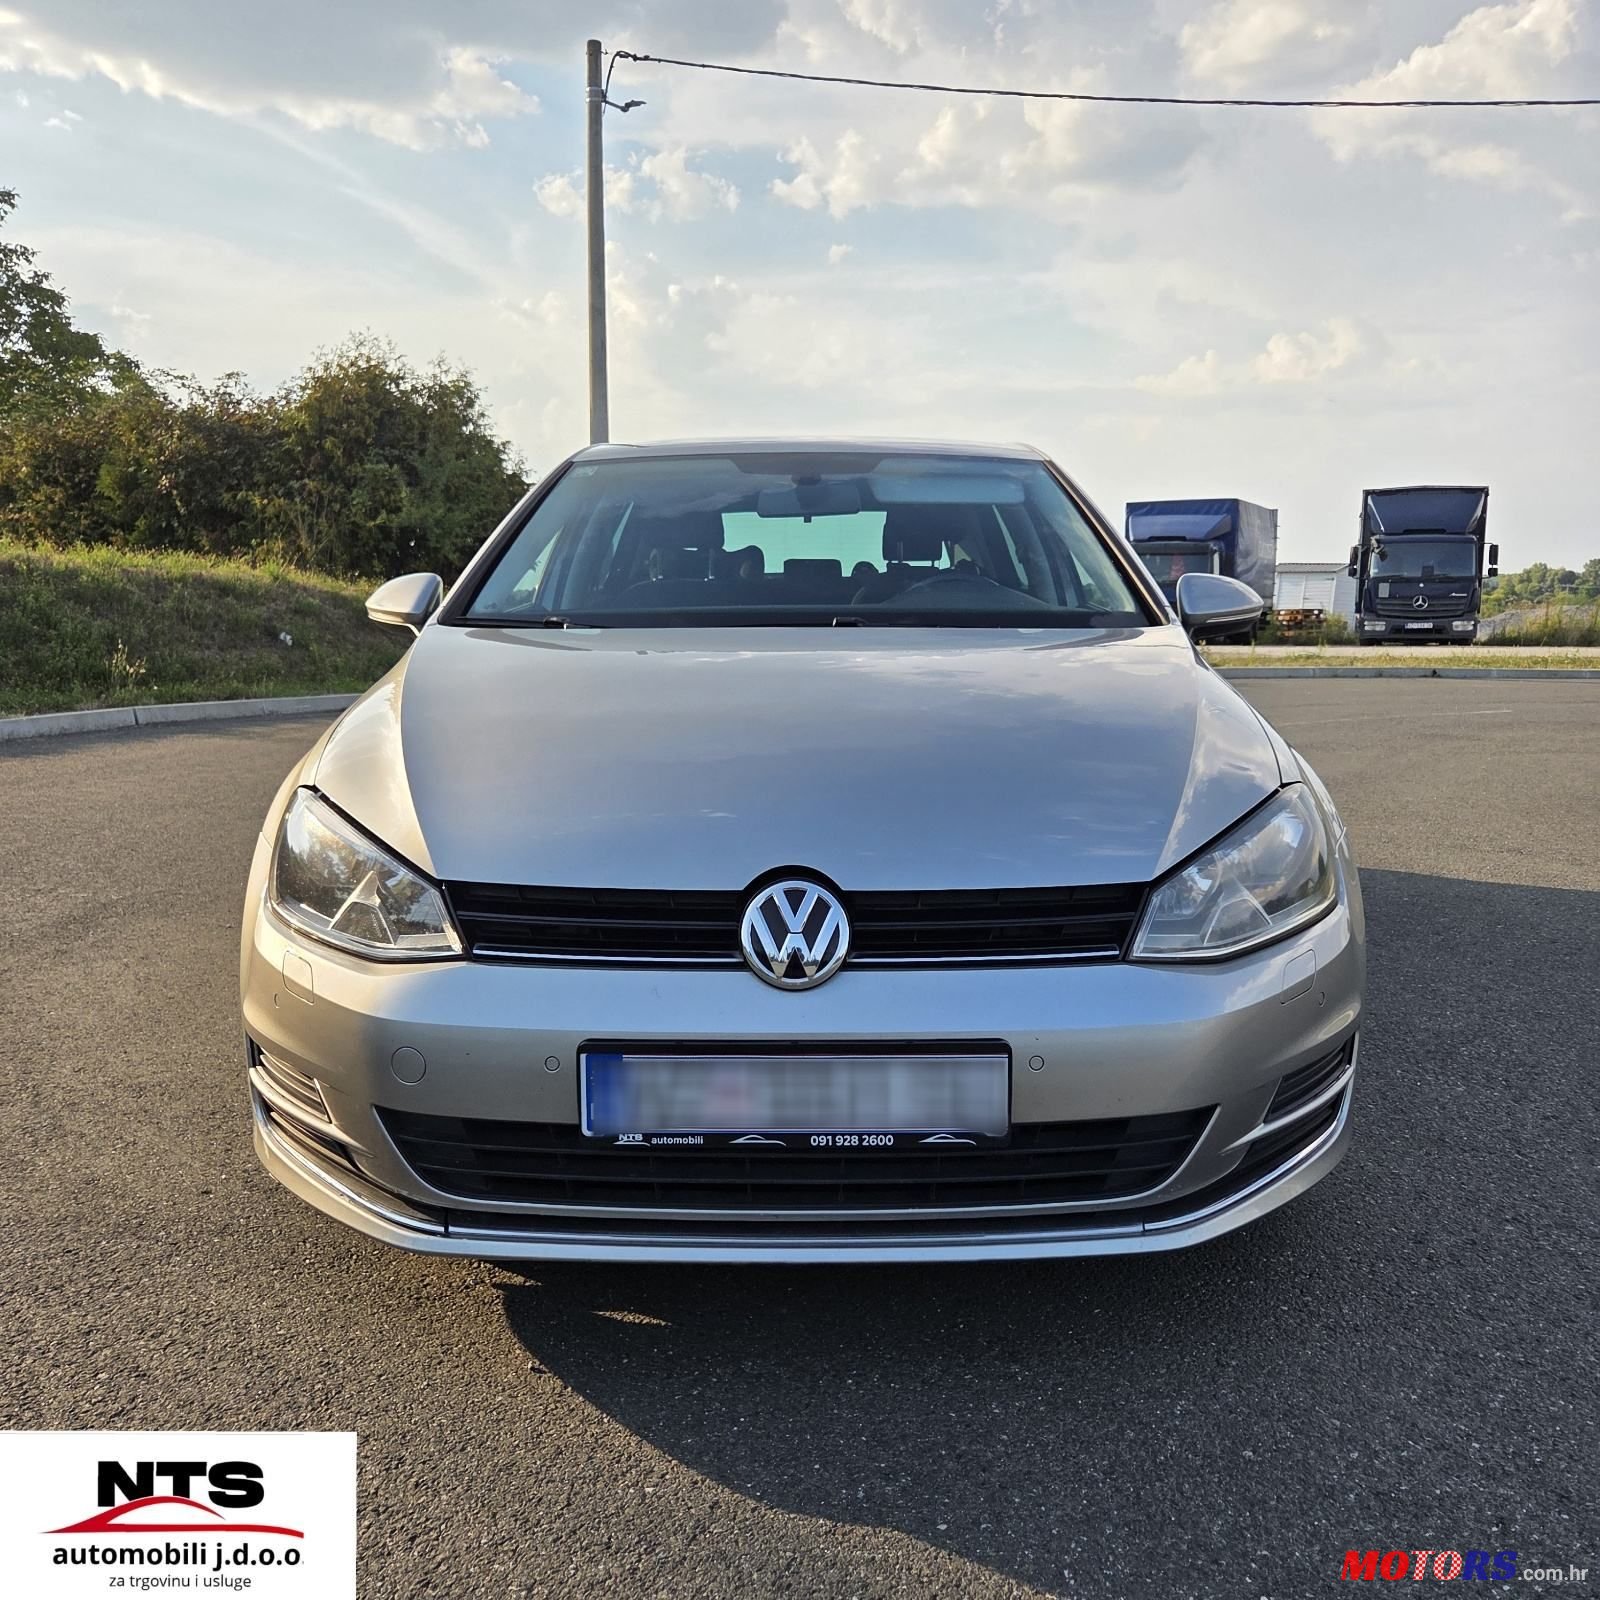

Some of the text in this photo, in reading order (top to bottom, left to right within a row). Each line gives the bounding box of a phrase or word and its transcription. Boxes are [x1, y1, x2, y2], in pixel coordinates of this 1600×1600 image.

[651, 1135, 704, 1145] automobili
[810, 1135, 894, 1146] 091 928 2600
